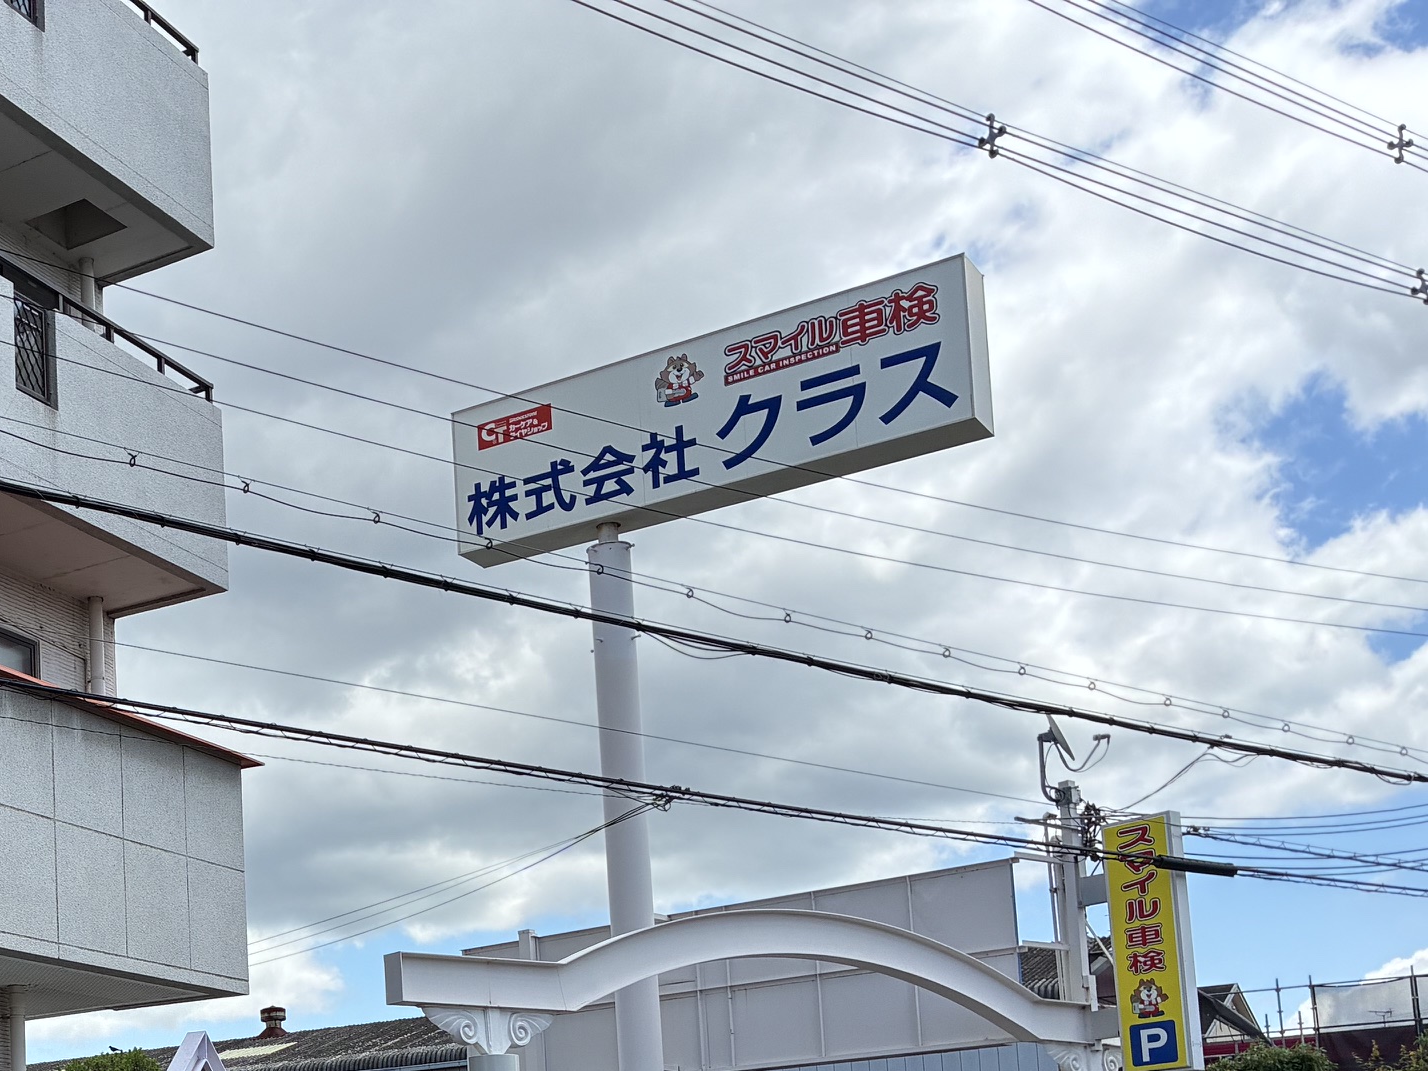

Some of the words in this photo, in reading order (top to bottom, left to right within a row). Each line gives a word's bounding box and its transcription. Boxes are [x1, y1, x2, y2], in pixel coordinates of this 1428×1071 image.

[724, 282, 940, 373] スマイル車検
[727, 369, 755, 383] SMILE
[758, 362, 776, 375] CAR
[779, 345, 837, 368] INSPECTION
[1117, 823, 1166, 975] スマイル車検
[1140, 1027, 1168, 1062] P
